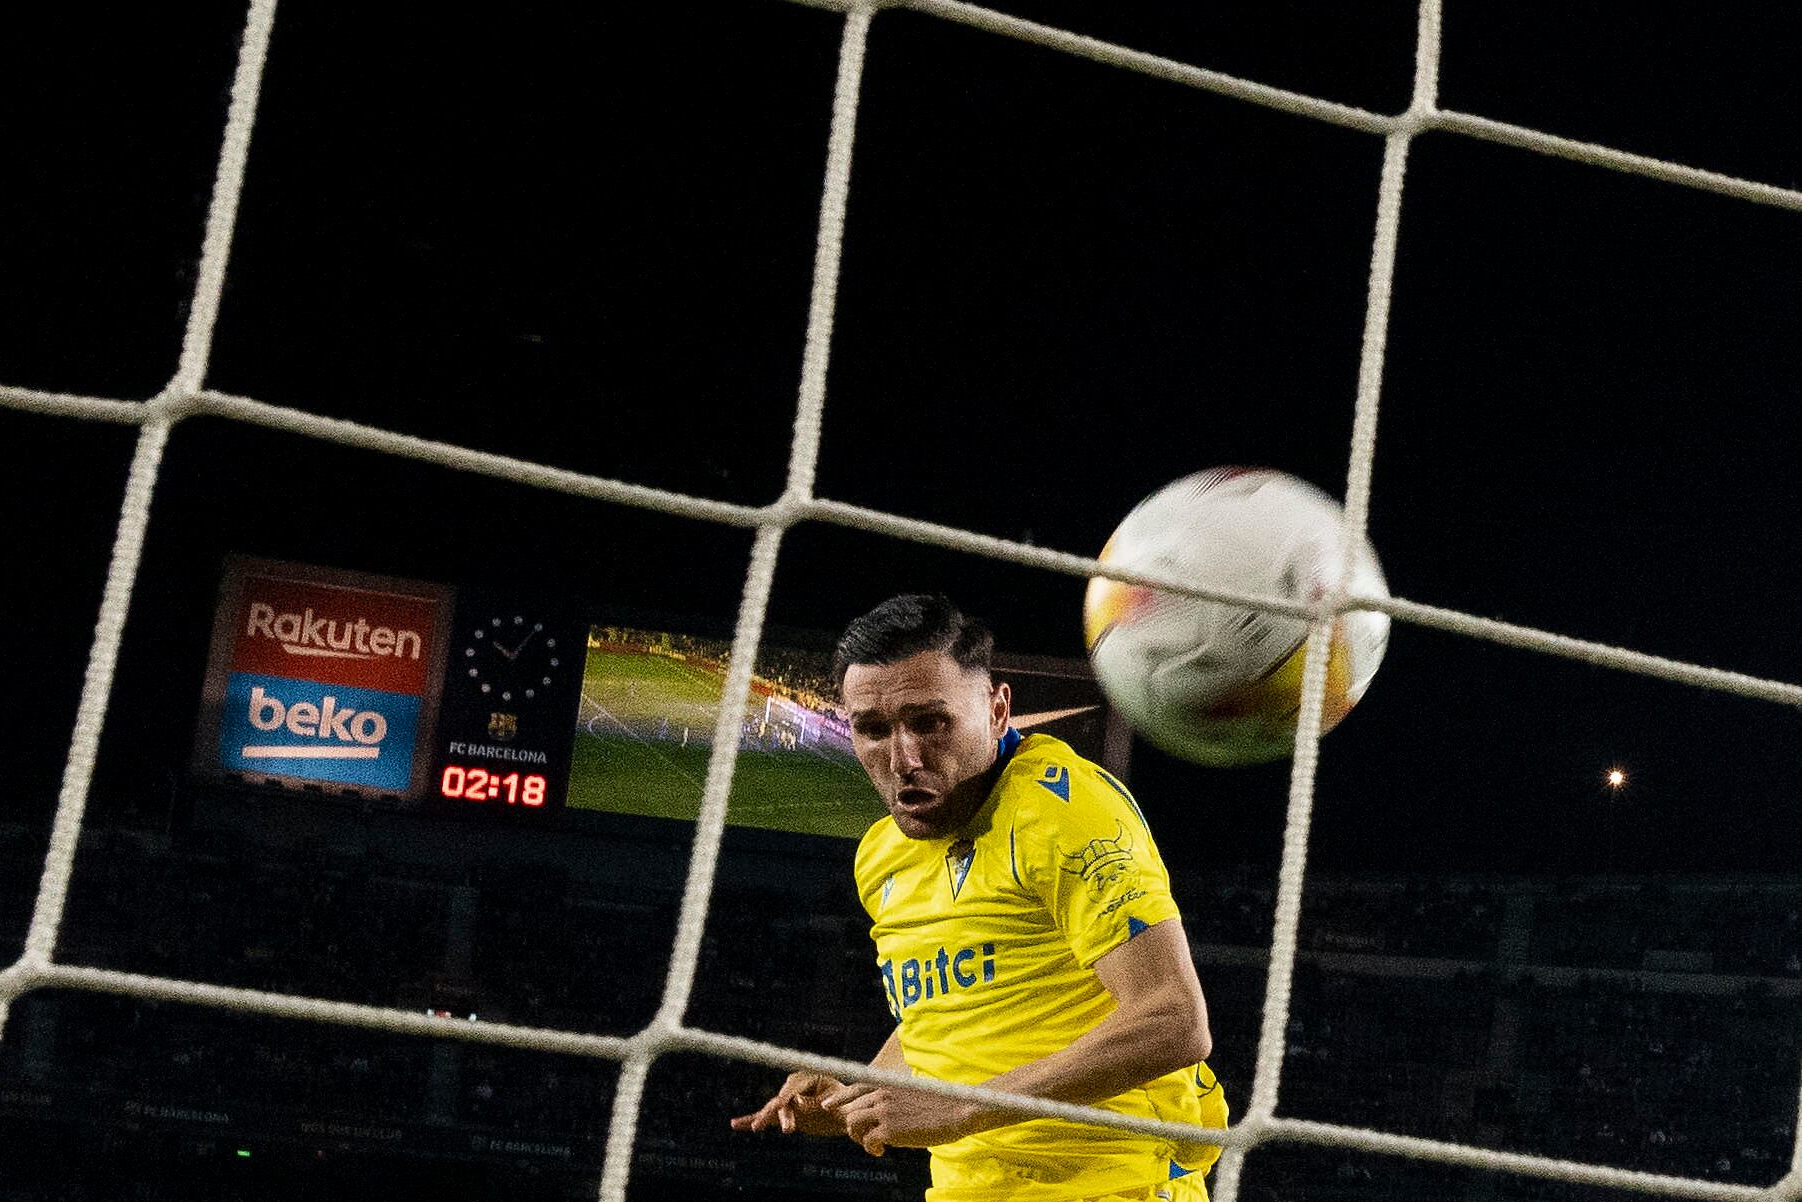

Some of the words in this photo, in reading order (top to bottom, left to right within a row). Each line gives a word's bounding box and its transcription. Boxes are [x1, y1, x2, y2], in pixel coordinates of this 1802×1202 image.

[246, 602, 422, 660] Rakuten
[248, 686, 388, 744] beko
[449, 741, 466, 755] FC
[467, 744, 548, 764] BARCELONA
[441, 766, 546, 806] 02:18
[901, 943, 997, 1008] Bitci
